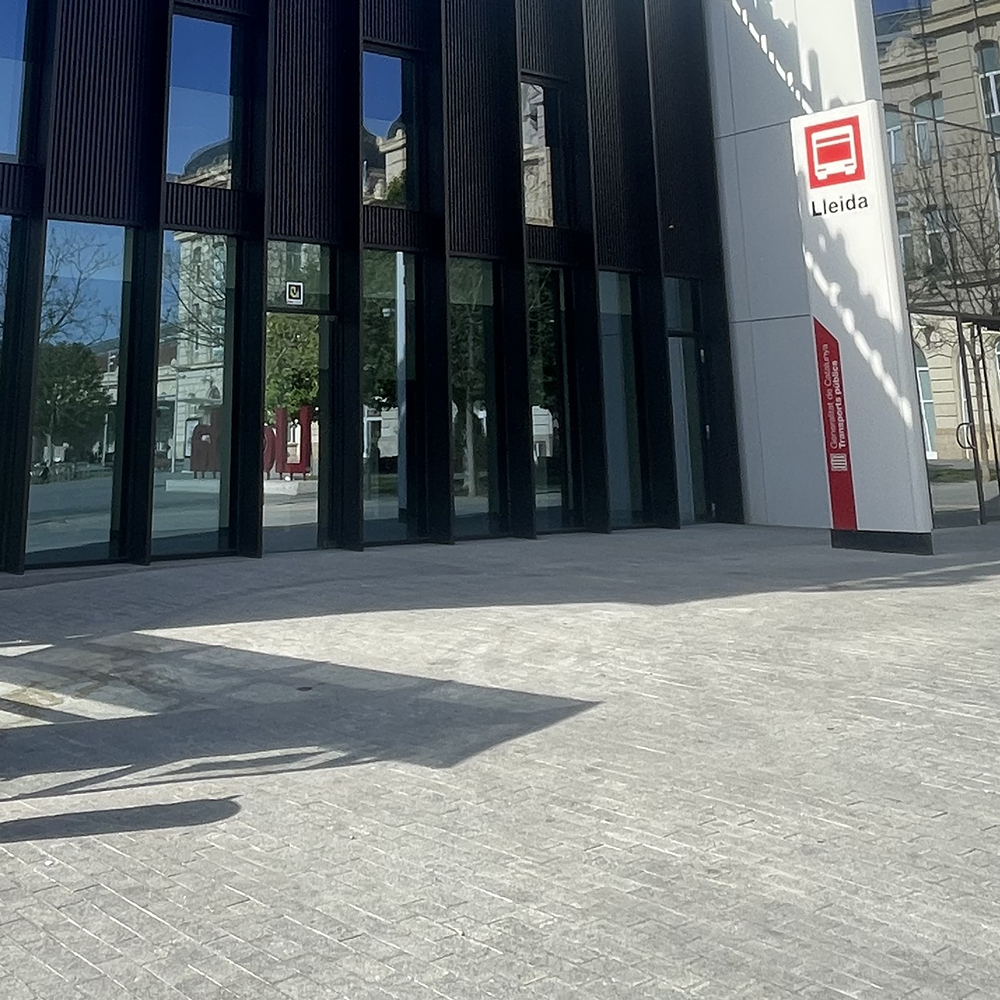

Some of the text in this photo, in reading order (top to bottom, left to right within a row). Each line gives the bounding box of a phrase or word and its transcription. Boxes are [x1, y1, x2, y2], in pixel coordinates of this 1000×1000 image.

[811, 194, 868, 217] Lleida
[822, 344, 838, 449] Generalitat de Catalunya
[835, 397, 846, 449] Transports
